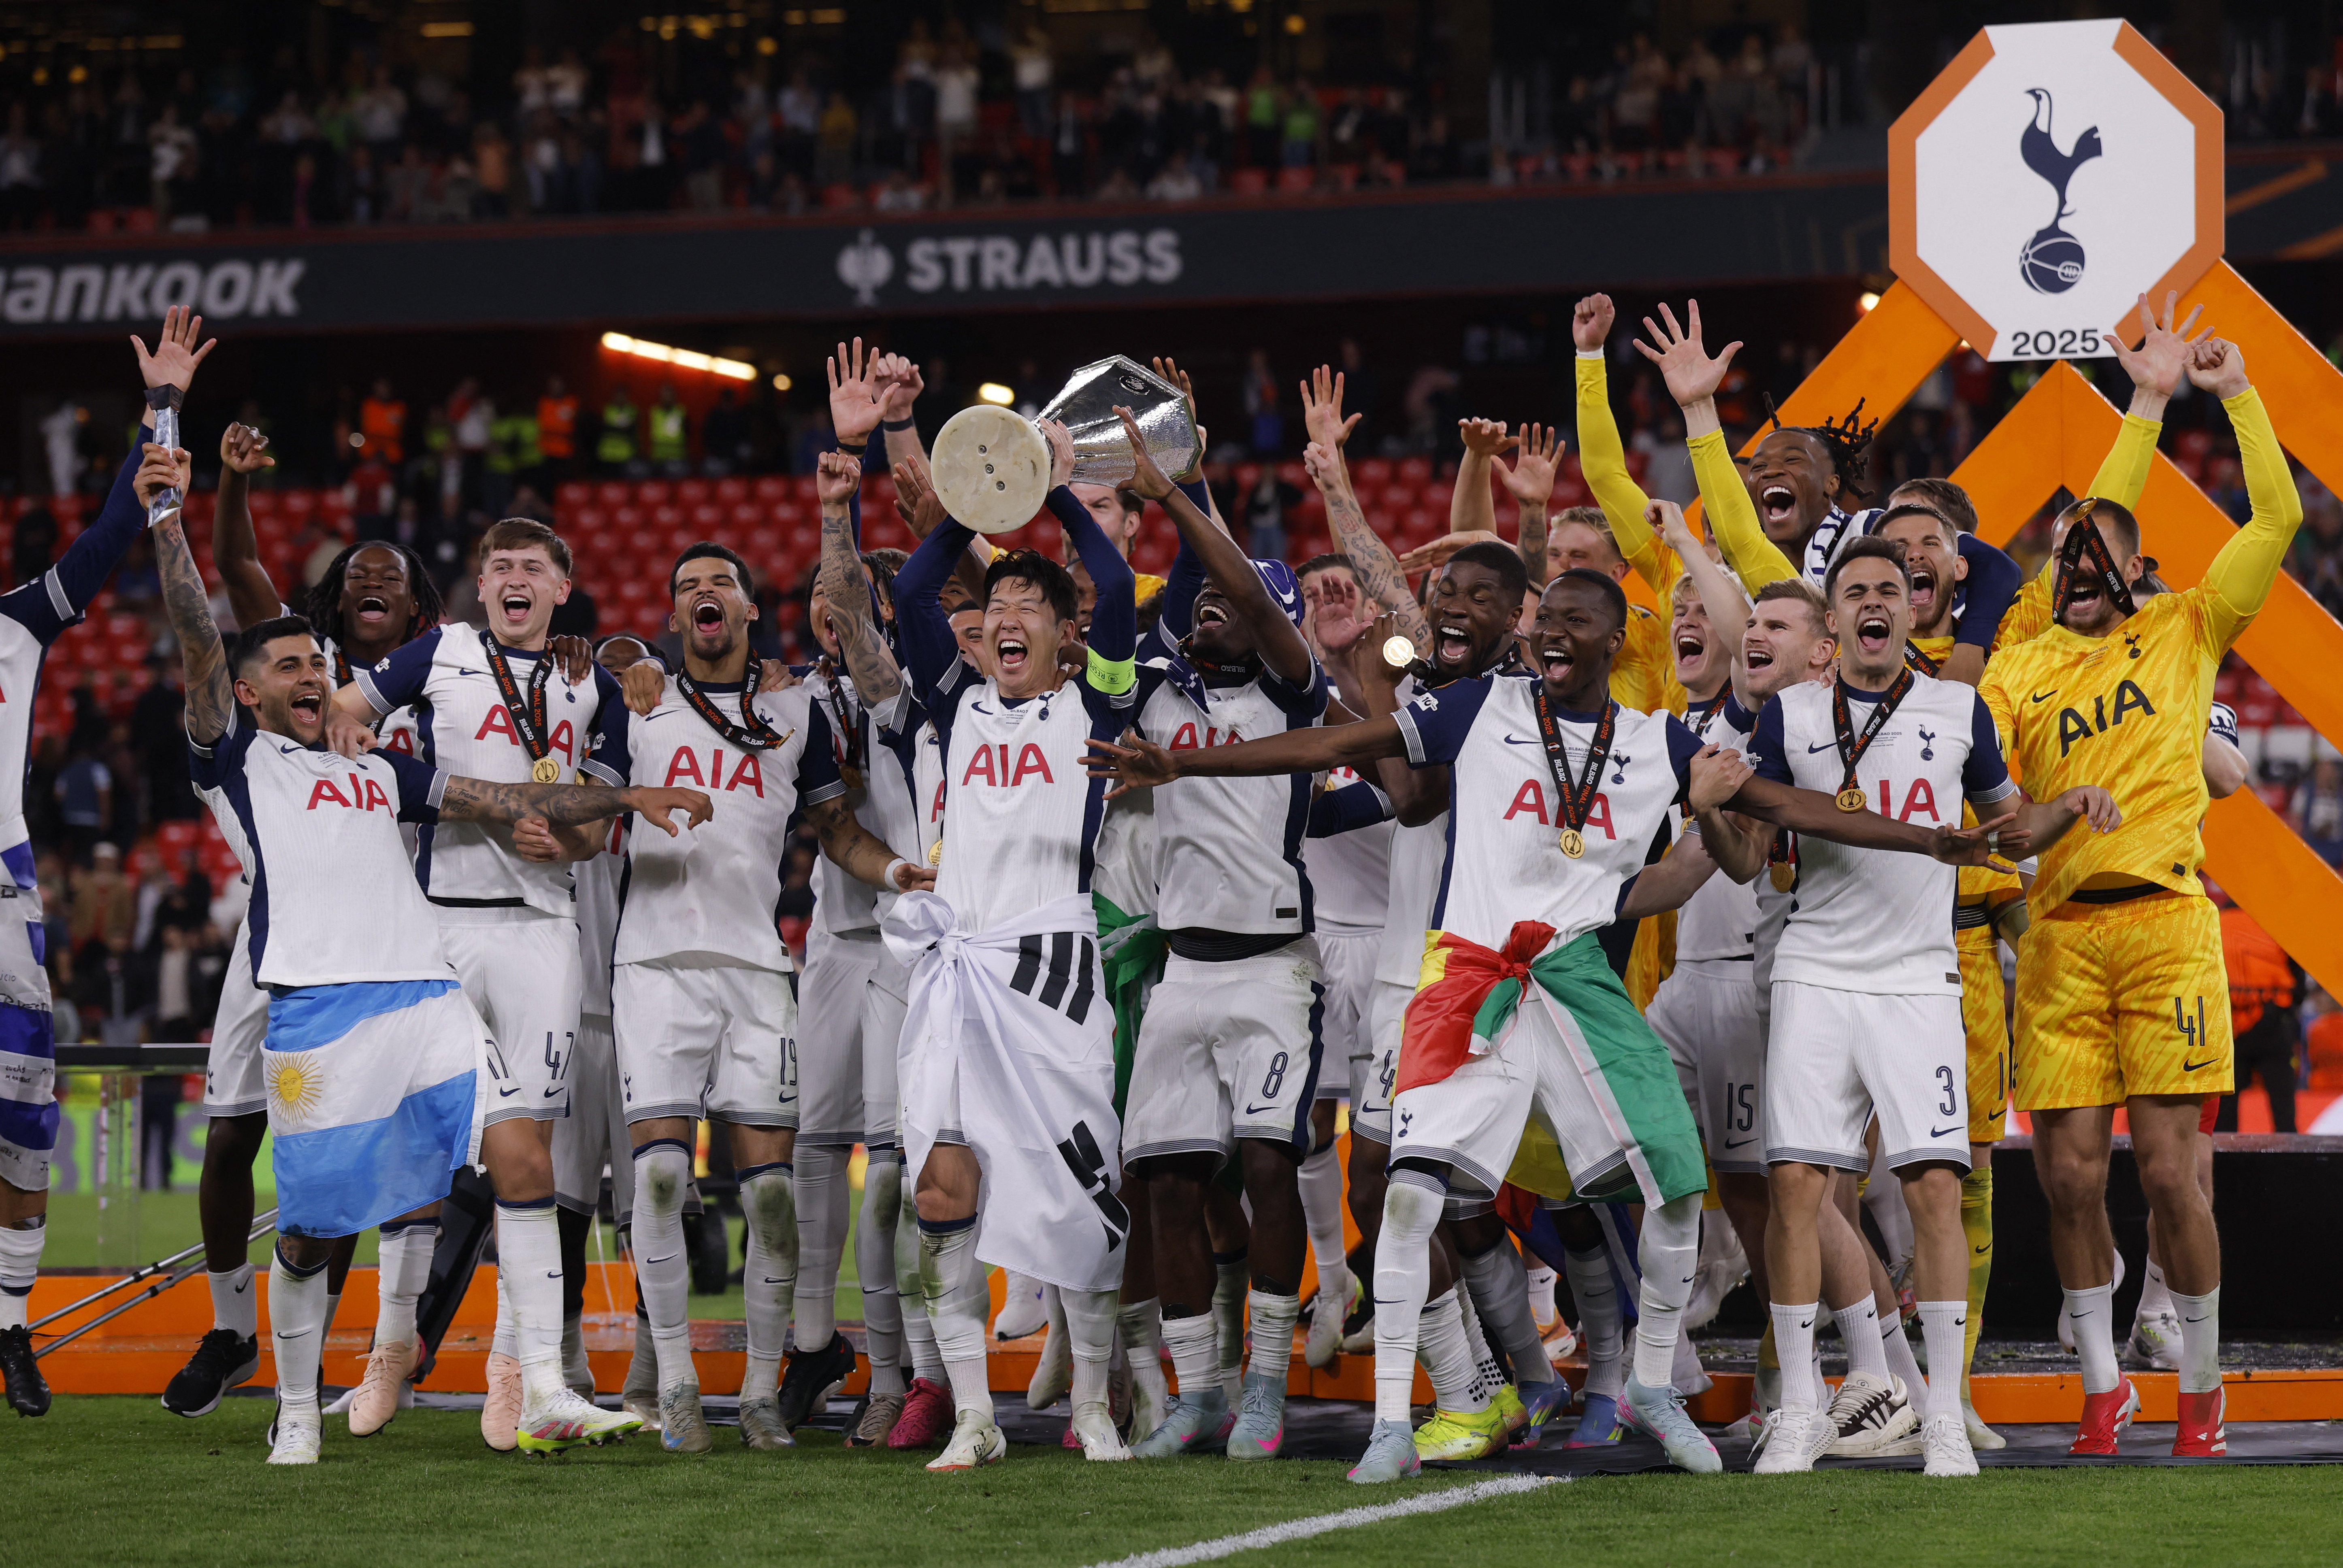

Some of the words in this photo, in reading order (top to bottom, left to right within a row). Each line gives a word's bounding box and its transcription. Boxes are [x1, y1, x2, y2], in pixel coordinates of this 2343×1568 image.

[906, 228, 1183, 293] STRAUSS
[0, 259, 305, 323] ankook
[2012, 329, 2100, 357] 2025
[2090, 538, 2102, 554] 2025
[2098, 553, 2111, 572] FINAL
[2060, 575, 2068, 592] 2025
[492, 655, 503, 677] FINAL
[501, 677, 514, 695] 2025
[1915, 657, 1933, 677] FINAL
[691, 692, 709, 711] FINAL
[706, 708, 722, 725] 2025
[743, 693, 752, 711] FINAL
[1539, 695, 1548, 716] FINAL
[1710, 699, 1726, 715] 2025
[1891, 684, 1903, 700] 2025
[746, 712, 759, 730] 2025
[1542, 716, 1554, 735] 2025
[1600, 722, 1610, 740] 2025
[1837, 706, 1846, 725] 2025
[2060, 679, 2156, 758] AIA
[475, 704, 573, 767] AA
[530, 740, 543, 758] FINA
[664, 746, 765, 799] AIA
[962, 743, 1054, 787] AIA
[307, 772, 394, 819] AIA
[1560, 782, 1572, 803] FINAL
[1567, 805, 1577, 825] 2025
[1578, 785, 1591, 804] FINAL
[2175, 996, 2205, 1047] 41
[545, 1031, 575, 1081] 47
[780, 1037, 798, 1086] 19
[1262, 1051, 1288, 1099] 8
[1936, 1066, 1957, 1116] 3
[1727, 1083, 1754, 1132] 15
